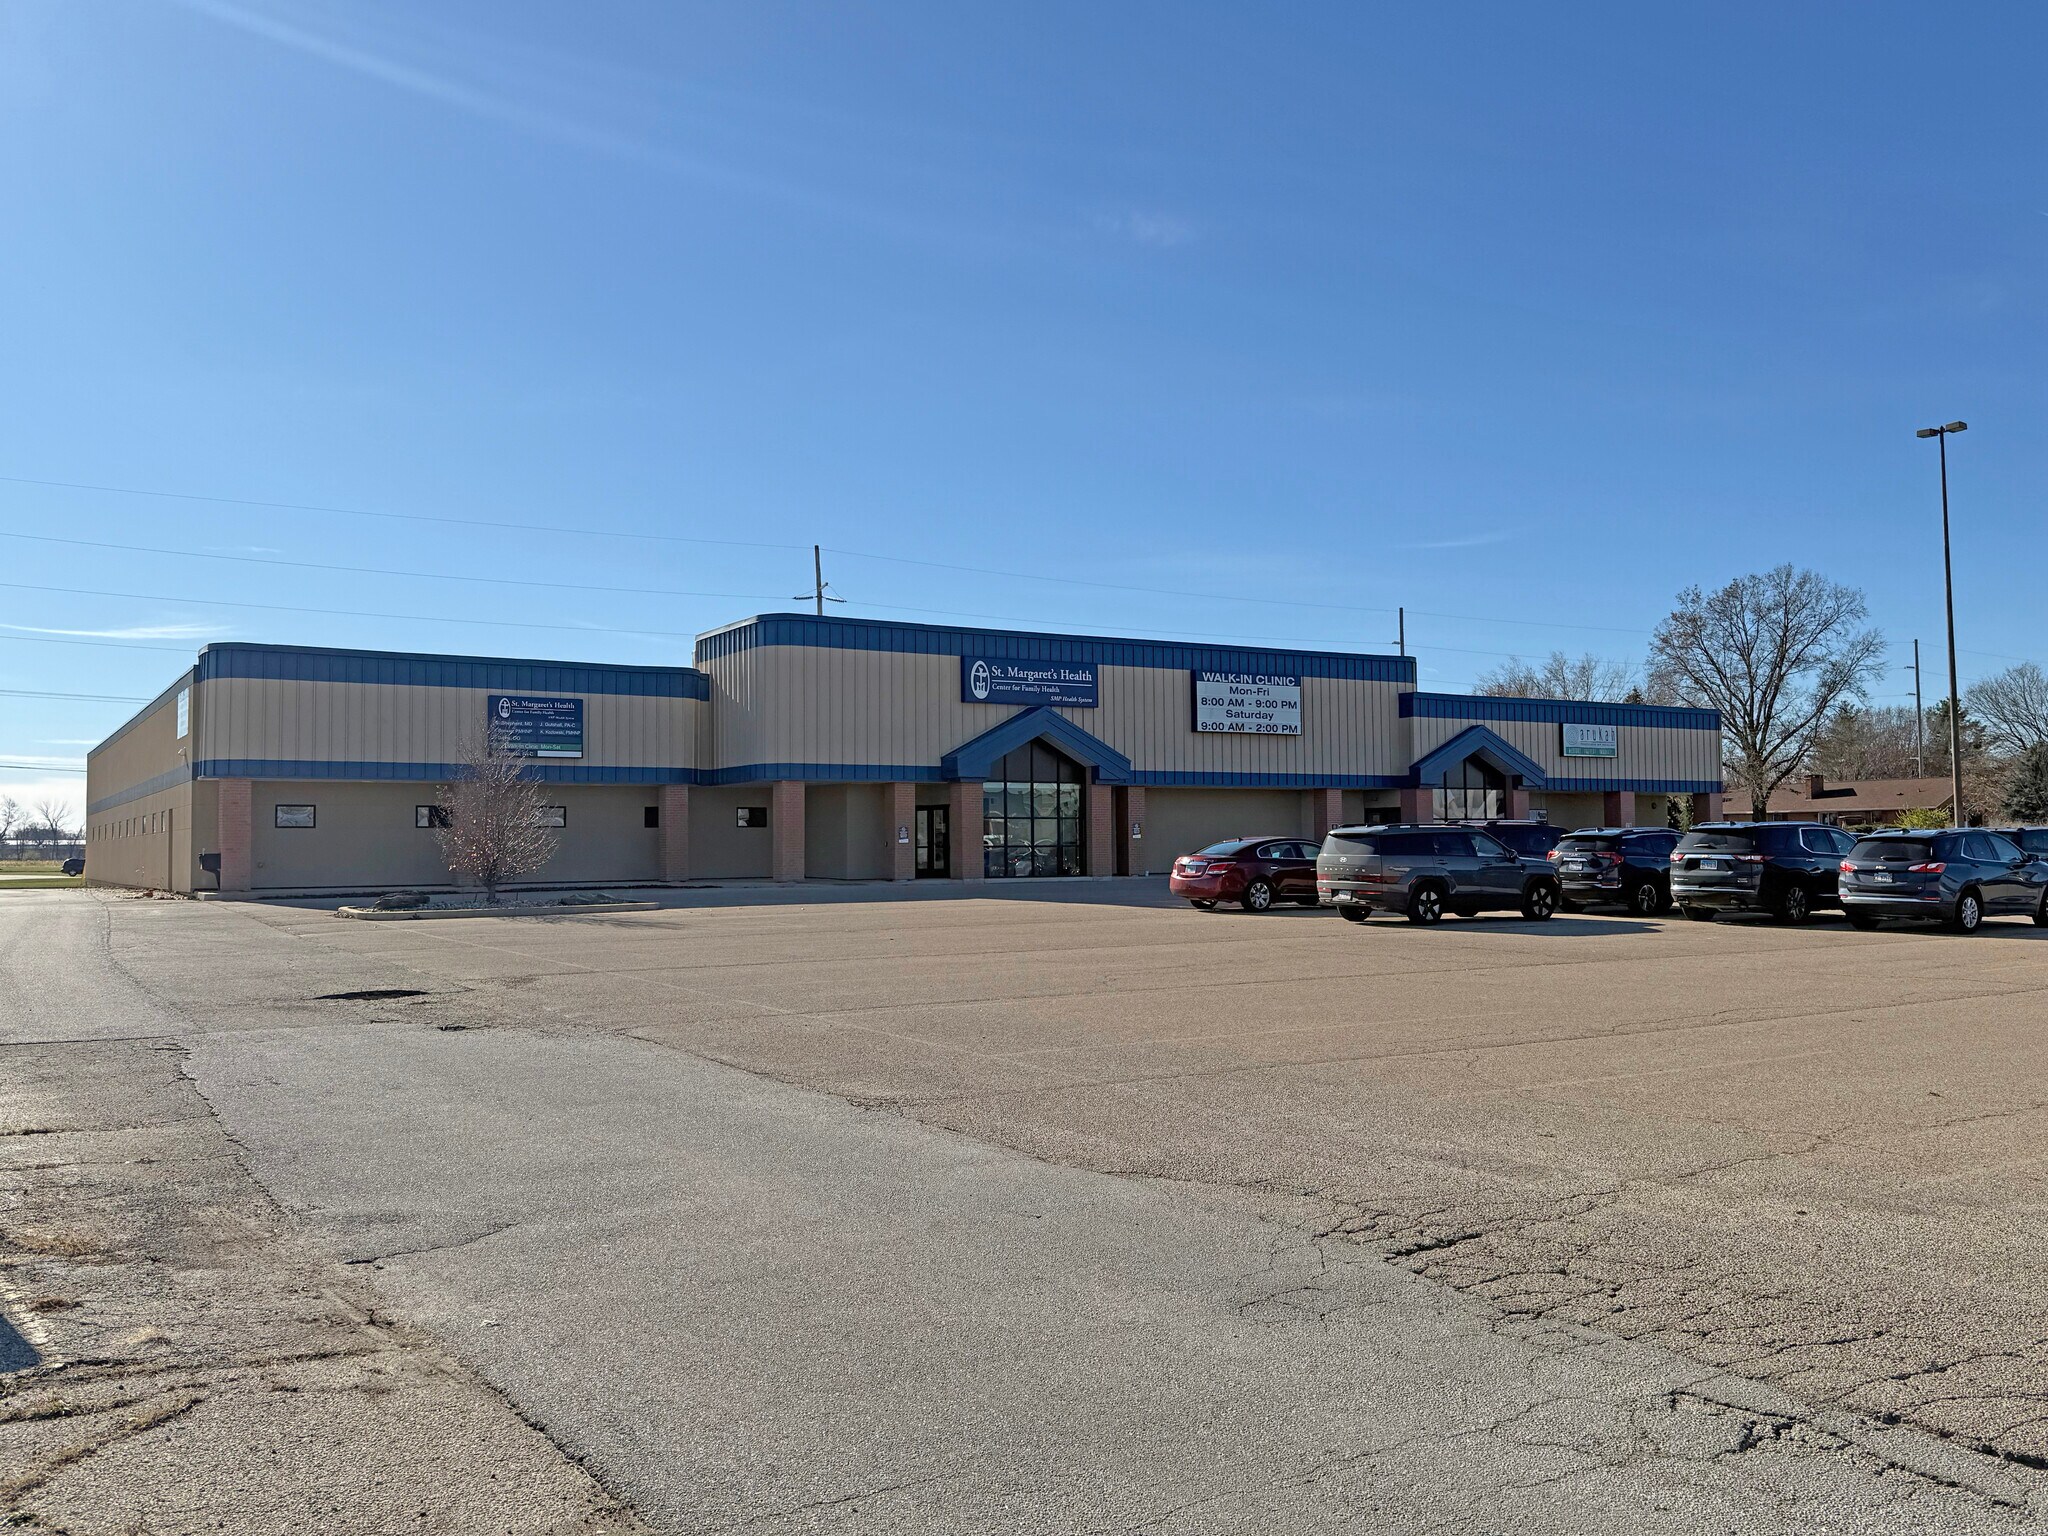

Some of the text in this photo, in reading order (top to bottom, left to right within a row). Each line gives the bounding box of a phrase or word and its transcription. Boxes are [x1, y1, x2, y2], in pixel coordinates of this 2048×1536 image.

[992, 666, 1092, 682] St. Margaret's Health
[1202, 672, 1296, 686] WALK-IN CLINIC
[1022, 685, 1040, 694] Family
[1229, 686, 1270, 696] Mon-Fri
[522, 701, 552, 709] Margaret's
[1200, 697, 1224, 706] 8:00
[1228, 698, 1244, 707] AM
[1255, 700, 1278, 708] 9:00
[1281, 700, 1297, 709] PM
[1226, 710, 1274, 722] Saturday
[1200, 722, 1225, 731] 9:00
[1228, 723, 1245, 731] AM
[1256, 724, 1278, 733] 2:00
[1282, 725, 1298, 733] PM
